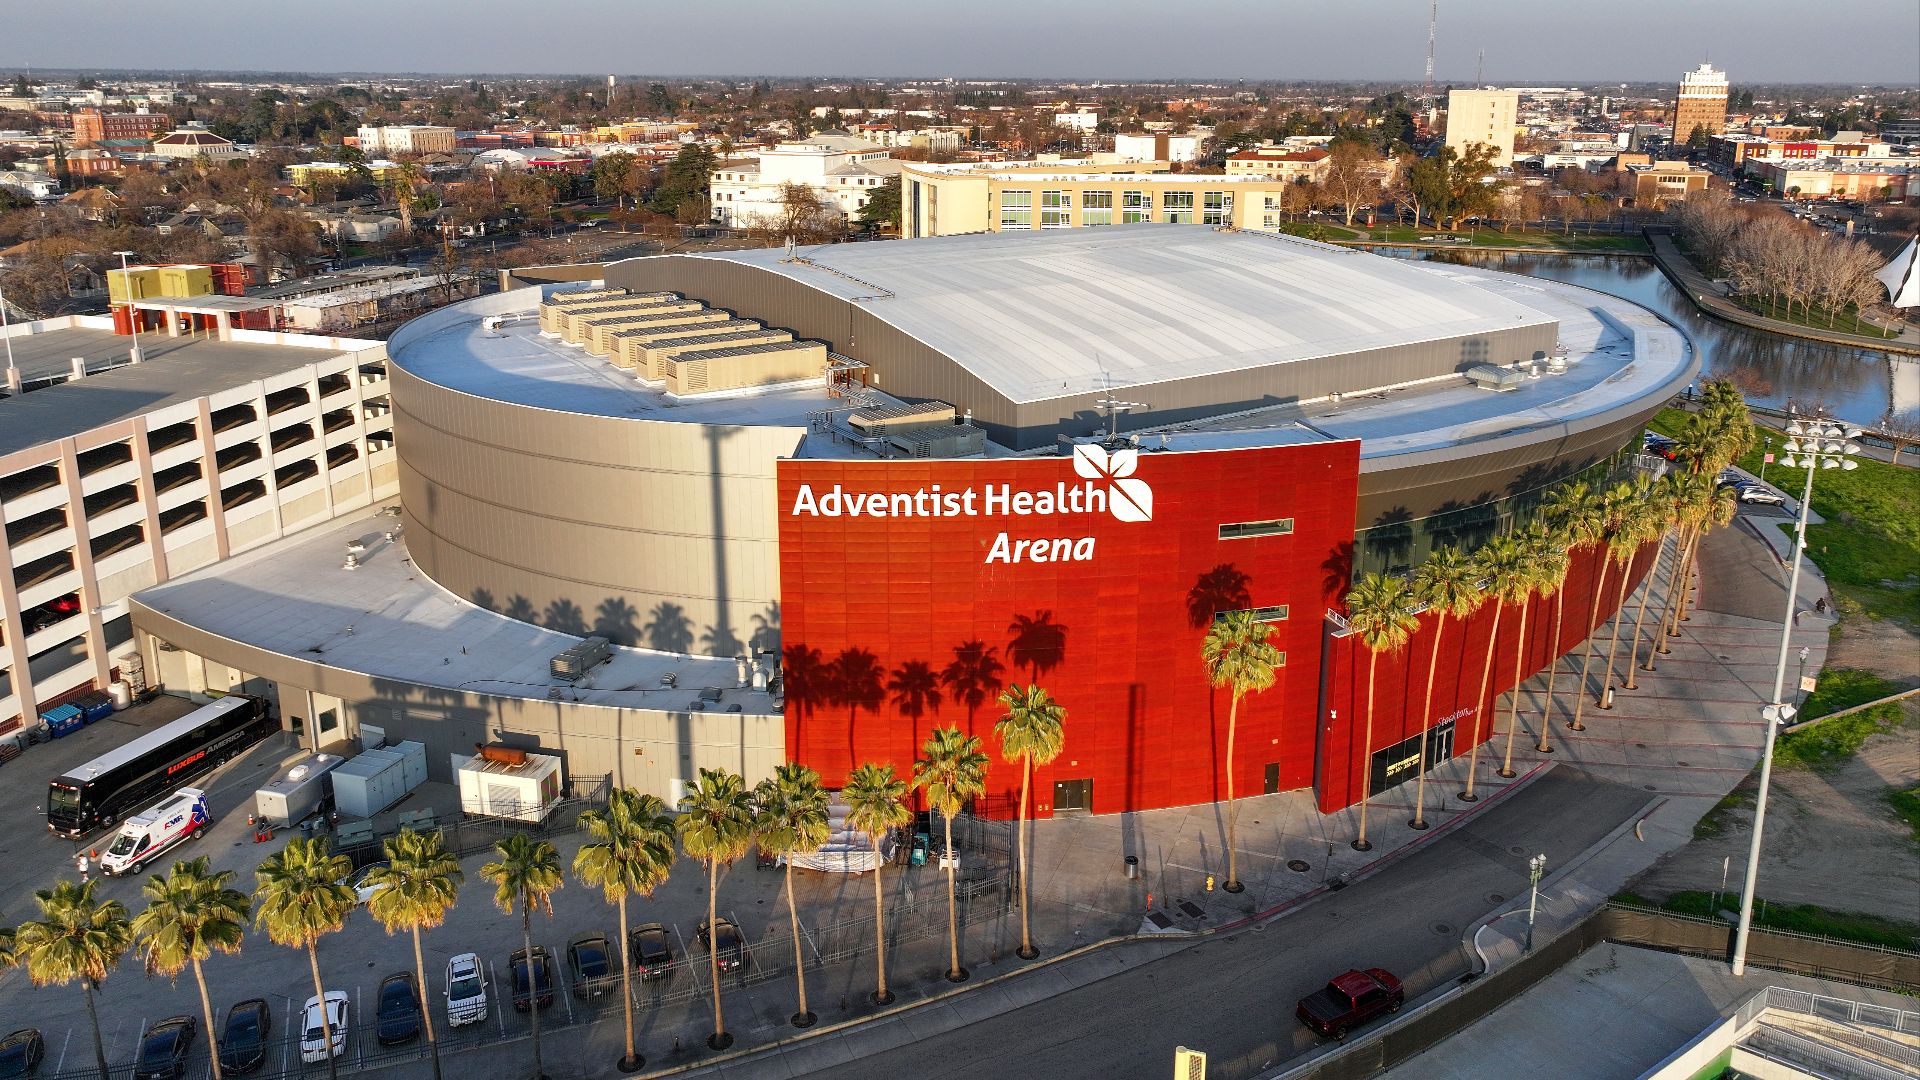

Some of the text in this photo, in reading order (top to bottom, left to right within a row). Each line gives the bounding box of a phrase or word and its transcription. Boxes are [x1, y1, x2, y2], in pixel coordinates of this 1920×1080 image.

[792, 480, 1106, 517] Adventist Health
[984, 531, 1096, 564] Arena
[206, 730, 245, 754] AMERICA
[164, 814, 184, 830] AMR
